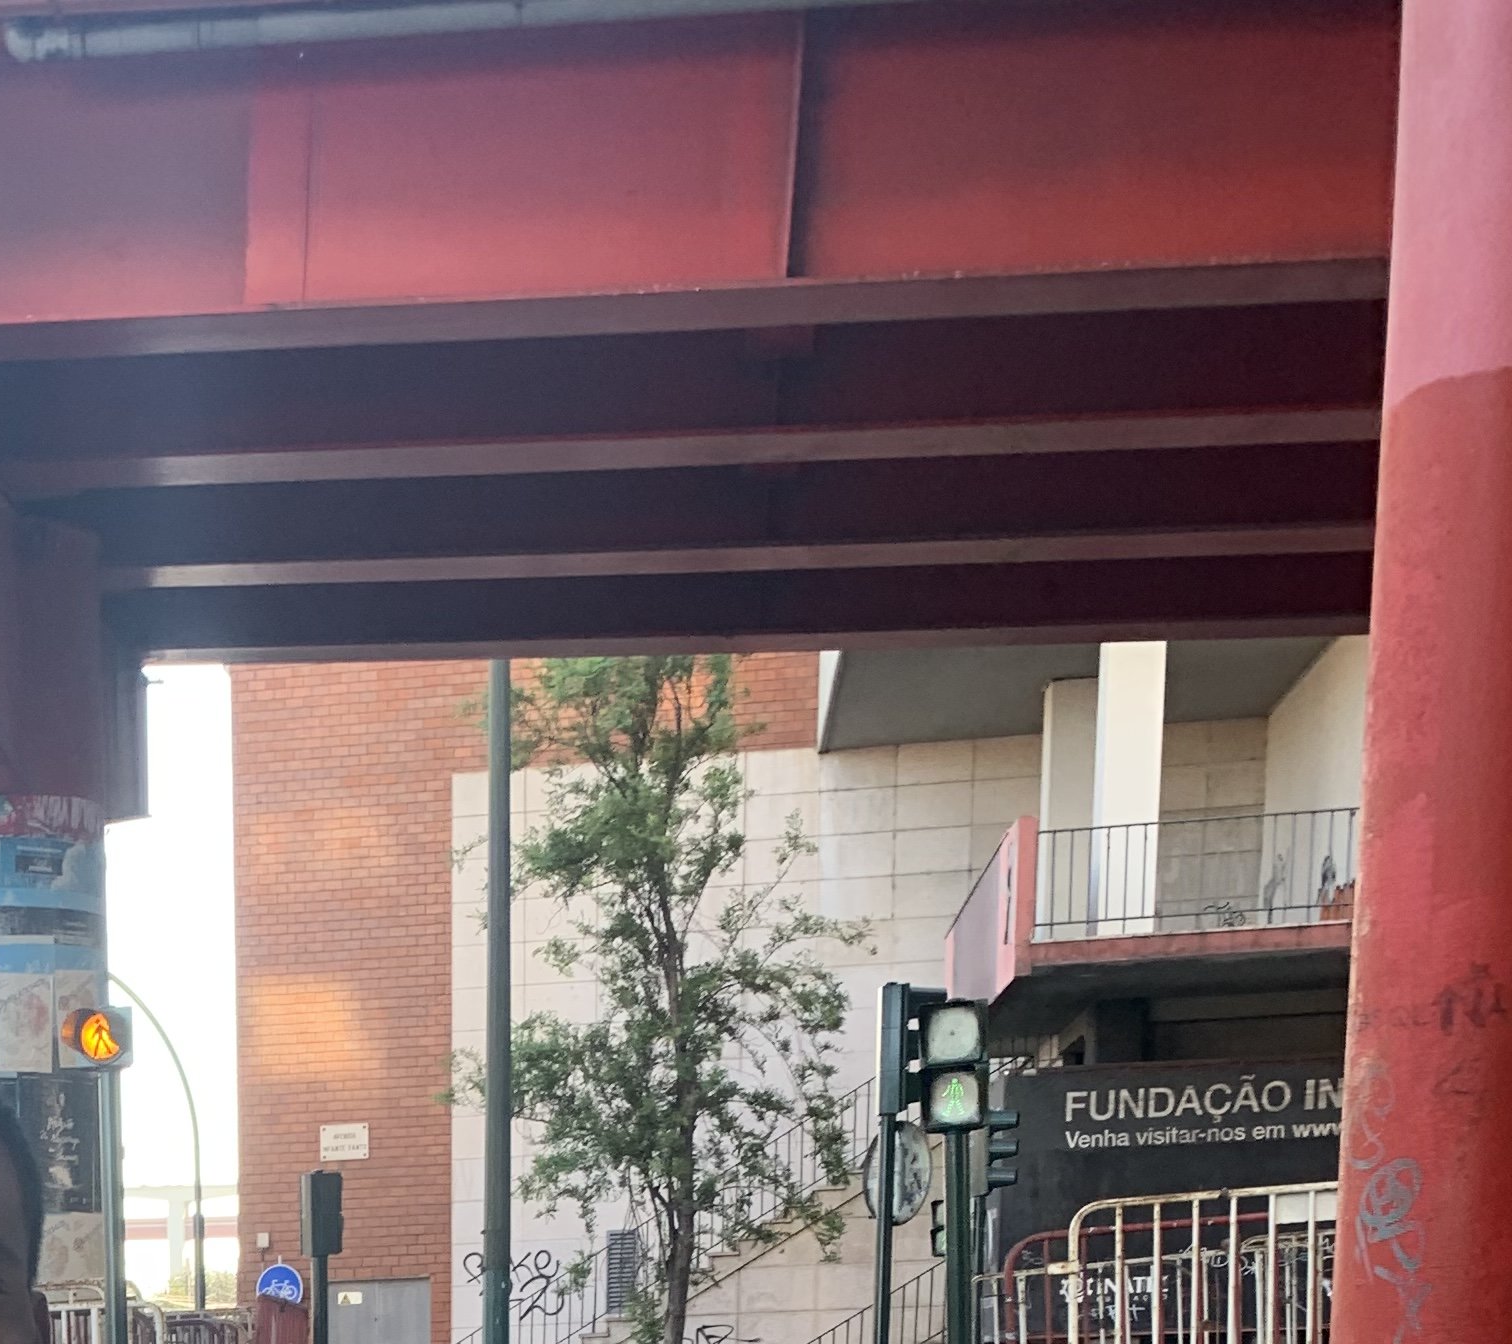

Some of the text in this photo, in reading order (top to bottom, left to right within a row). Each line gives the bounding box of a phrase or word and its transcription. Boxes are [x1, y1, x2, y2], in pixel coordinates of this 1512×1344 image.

[1064, 1074, 1292, 1123] FUNDAÇÃO
[1065, 1129, 1131, 1150] Venha
[1136, 1124, 1246, 1147] visitar-nos
[1252, 1123, 1286, 1141] em
